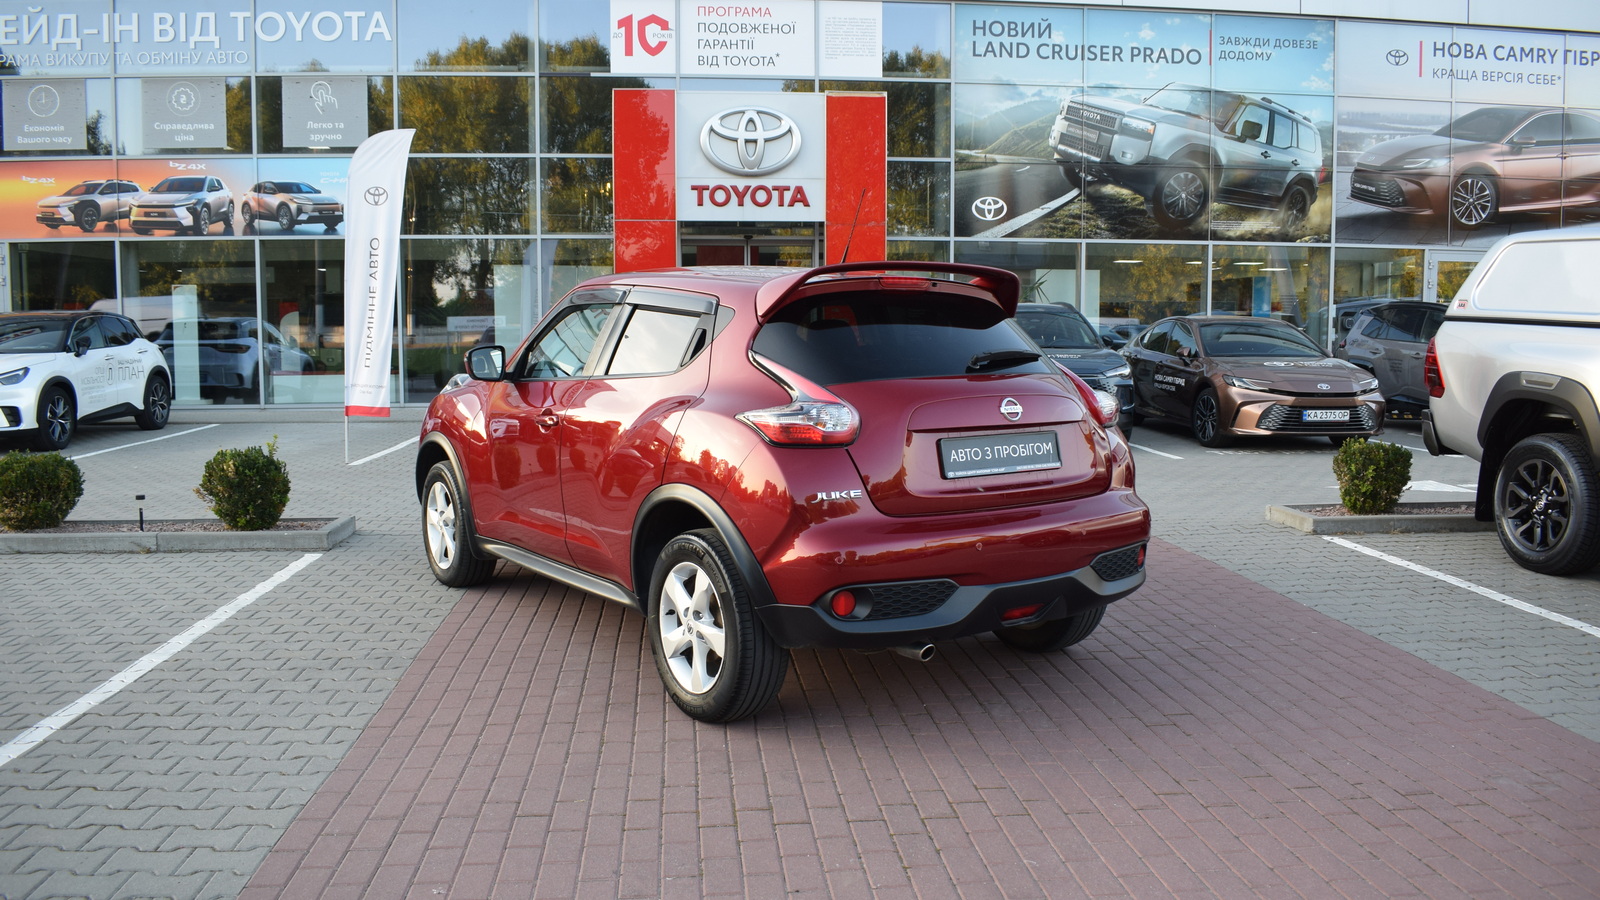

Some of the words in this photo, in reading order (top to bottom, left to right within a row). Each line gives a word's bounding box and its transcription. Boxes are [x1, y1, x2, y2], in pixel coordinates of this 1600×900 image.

[697, 5, 772, 18] ПРОГРАМА
[0, 6, 140, 51] ЕЙД-ІН
[153, 11, 220, 50] ВІД
[230, 10, 393, 43] TOYOTA
[697, 21, 797, 35] ПОДОВЖЕНОЇ
[972, 17, 1052, 39] НОВИЙ
[697, 37, 755, 50] ГАРАНТІЇ
[1218, 35, 1271, 48] ЗАВЖДИ
[1273, 37, 1319, 50] ДОВЕЗЕ
[46, 52, 110, 67] ВИКУПУ
[114, 52, 133, 65] ТА
[137, 51, 202, 65] ОБМІНУ
[206, 50, 249, 64] АВТО
[972, 40, 1031, 59] LAND
[1036, 43, 1124, 63] CRUISER
[1130, 45, 1203, 66] PRADO
[1218, 50, 1273, 62] ДОДОМУ
[1432, 41, 1488, 61] НОВА
[1492, 44, 1558, 65] CAMRY
[697, 55, 720, 68] ВІД
[1432, 67, 1478, 83] КРАЩА
[1481, 70, 1523, 84] ВЕРСІЯ
[24, 123, 65, 132] Економія
[154, 121, 215, 132] Справедлива
[306, 121, 333, 129] Легко
[17, 136, 51, 144] Вашого
[52, 136, 73, 145] часу
[174, 133, 195, 142] ціна
[309, 133, 342, 142] зручно
[690, 184, 811, 208] TOYOTA
[368, 237, 380, 281] АВТО
[364, 285, 377, 368] ПІДМІННЕ
[1307, 411, 1318, 419] KA
[1319, 411, 1337, 419] 2375
[1338, 411, 1349, 419] OP
[950, 447, 982, 463] АВТО
[984, 446, 992, 460] З
[994, 441, 1053, 459] ПРОБІГОМ
[810, 489, 862, 504] JUKE
